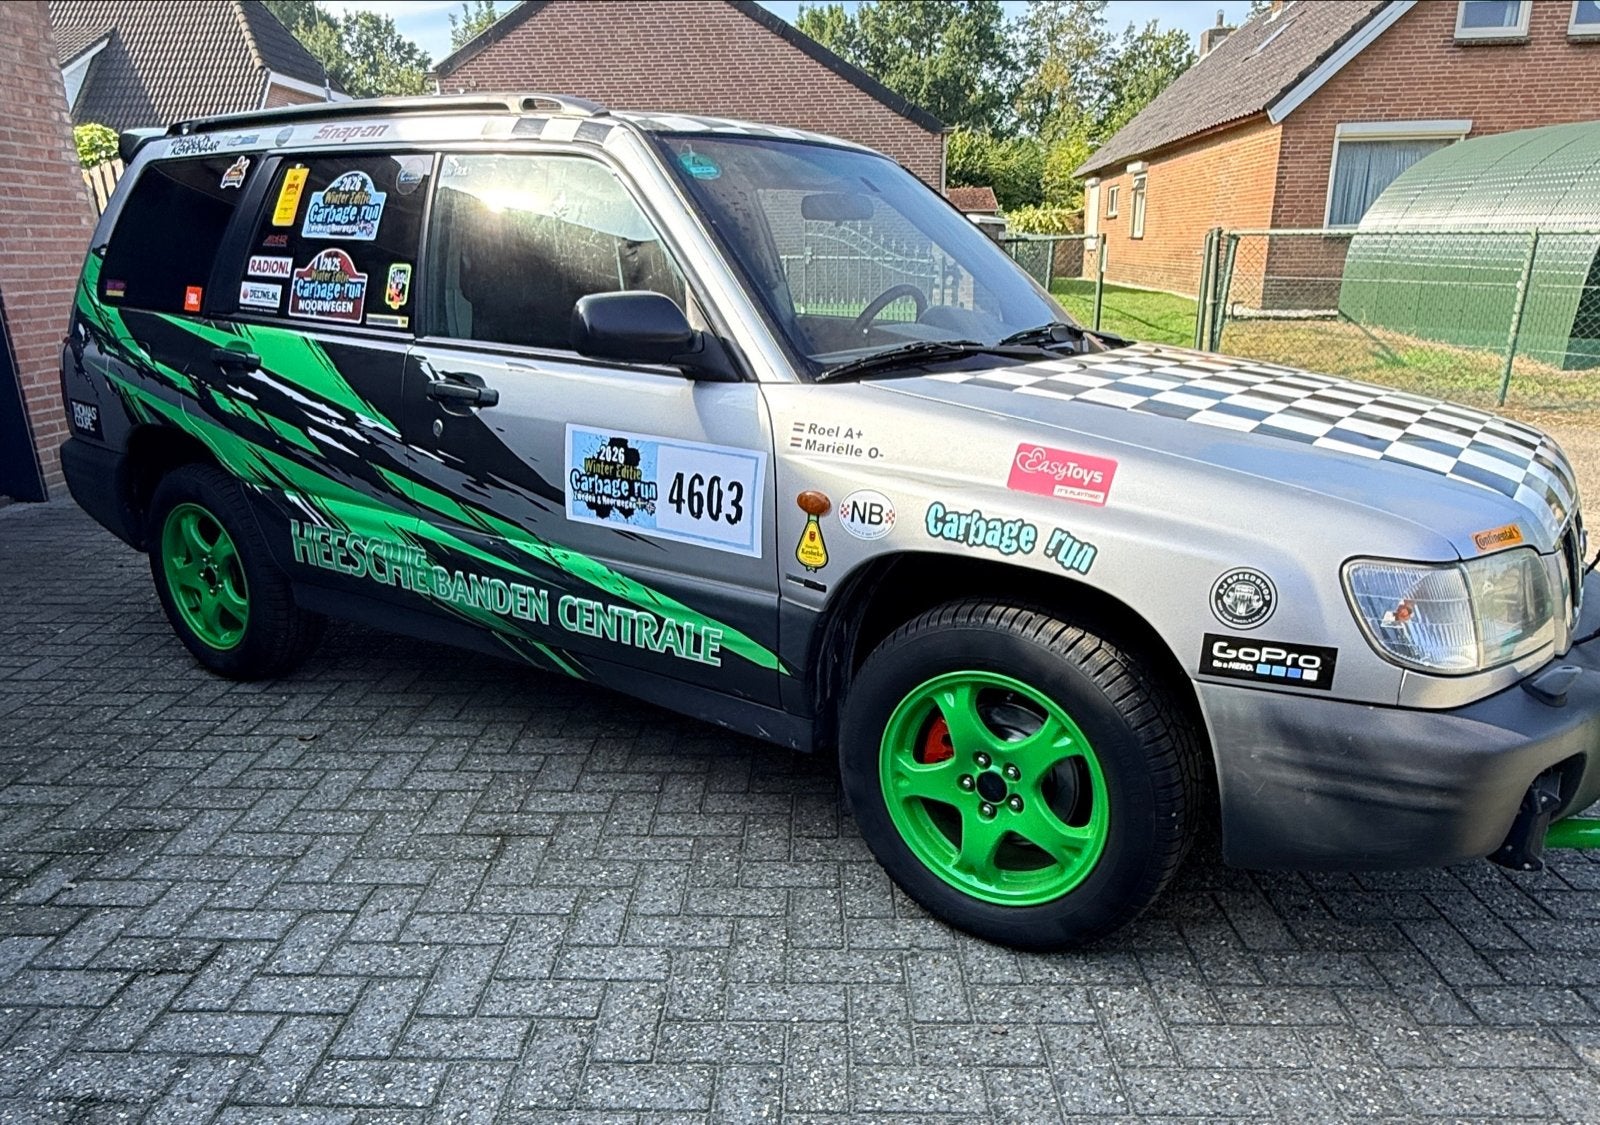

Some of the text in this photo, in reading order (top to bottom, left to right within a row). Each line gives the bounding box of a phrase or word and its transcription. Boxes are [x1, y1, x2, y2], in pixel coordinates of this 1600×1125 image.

[309, 203, 380, 223] Carbage run
[250, 259, 290, 275] RADIONL
[296, 277, 361, 300] Carbage run
[298, 300, 353, 313] NOORWEGEN
[807, 422, 863, 440] Roel A+
[599, 445, 625, 464] 2026
[805, 438, 863, 457] Mariëlle
[585, 459, 642, 481] Winter Editie
[1016, 447, 1104, 486] EasyToys
[570, 468, 658, 500] Carbage run
[668, 472, 744, 525] 4603
[850, 500, 884, 526] NB
[925, 501, 1098, 576] Carbage run
[1474, 528, 1515, 550] Continental
[290, 518, 723, 667] HEESCHE BANDEN CENTRALE
[1212, 641, 1321, 669] GoPro
